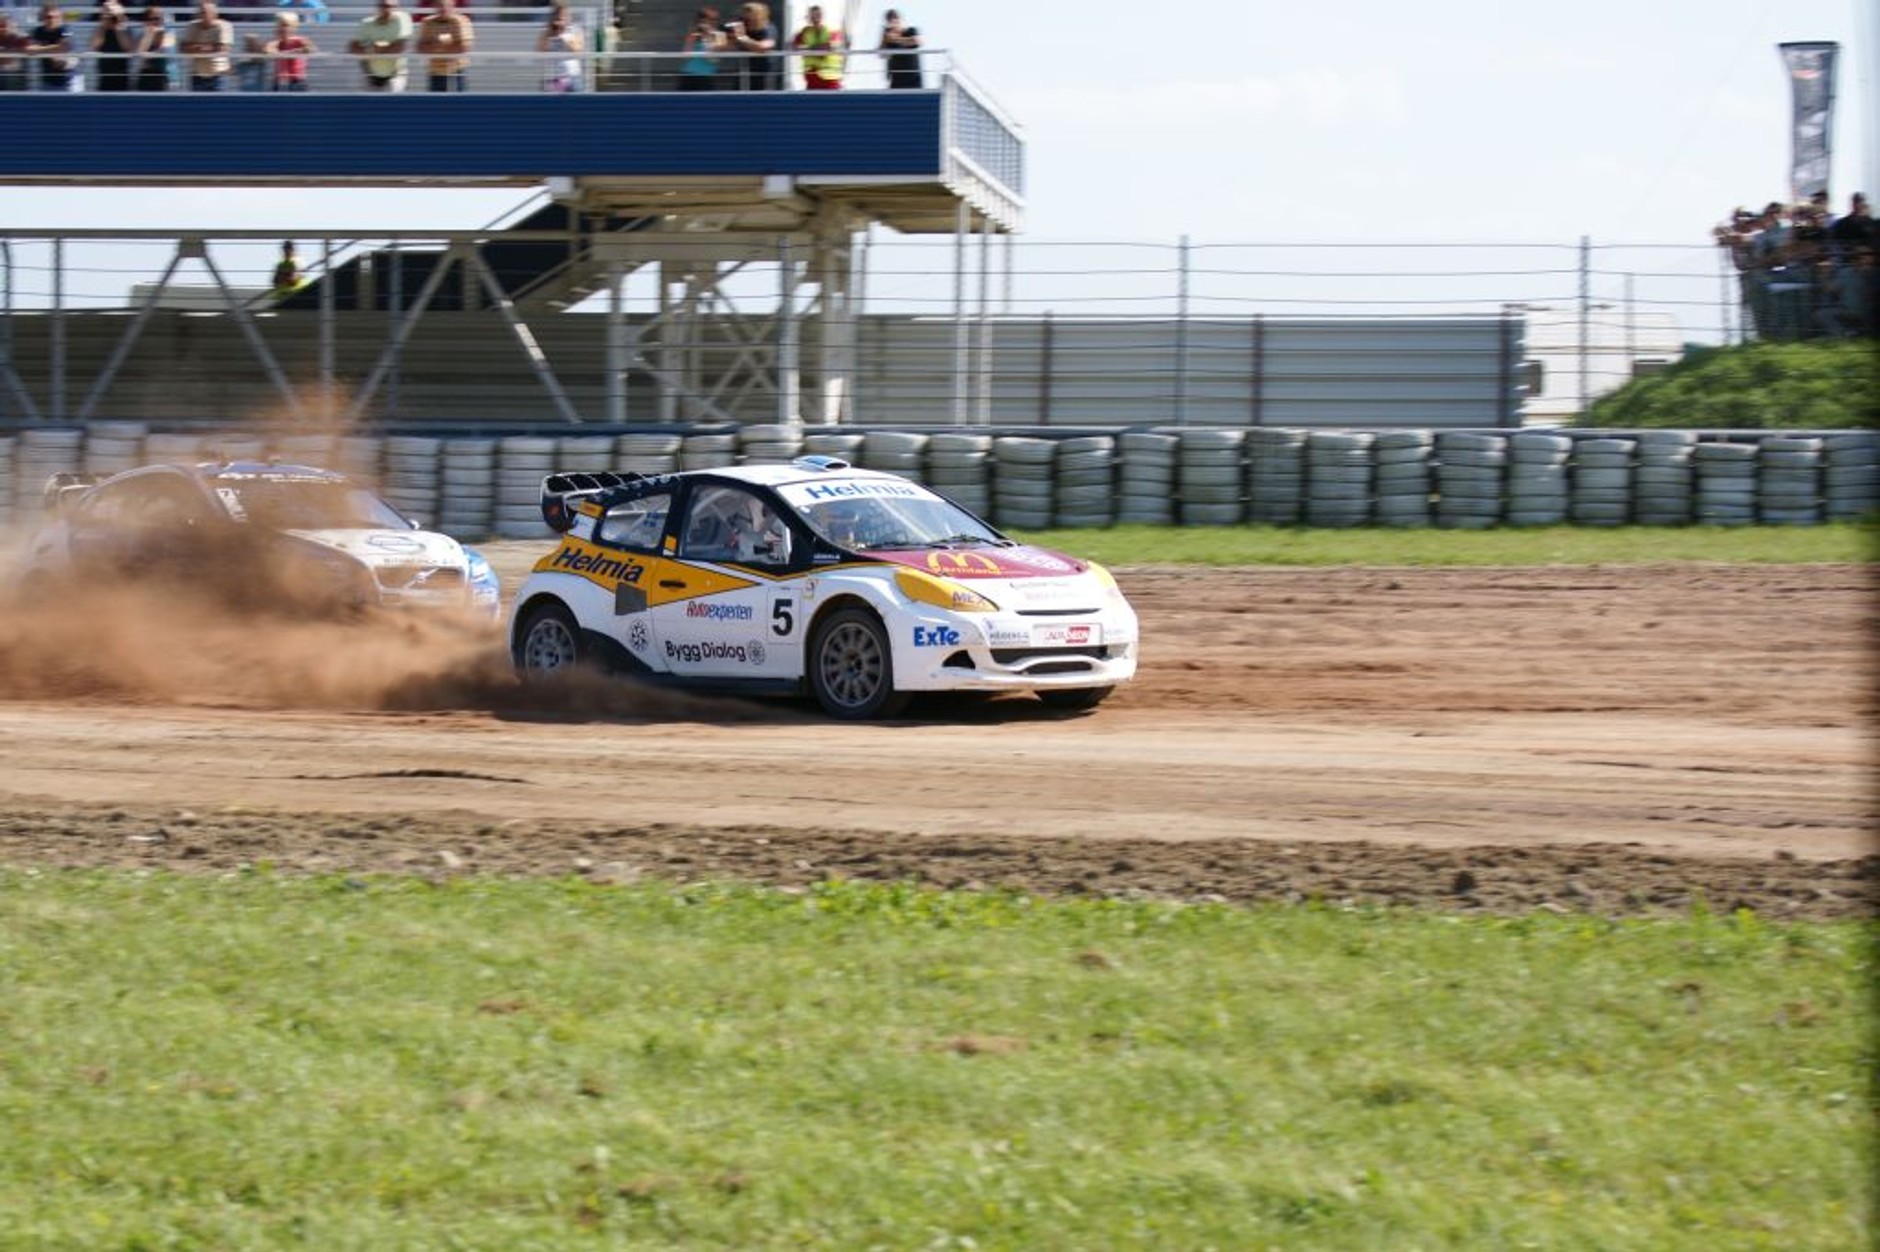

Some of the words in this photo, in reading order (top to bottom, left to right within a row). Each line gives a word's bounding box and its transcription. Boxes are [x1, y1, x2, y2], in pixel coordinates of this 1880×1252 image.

[805, 483, 915, 498] Helmia
[552, 546, 644, 583] Helmia
[772, 599, 793, 636] 5
[914, 626, 960, 647] ExTe
